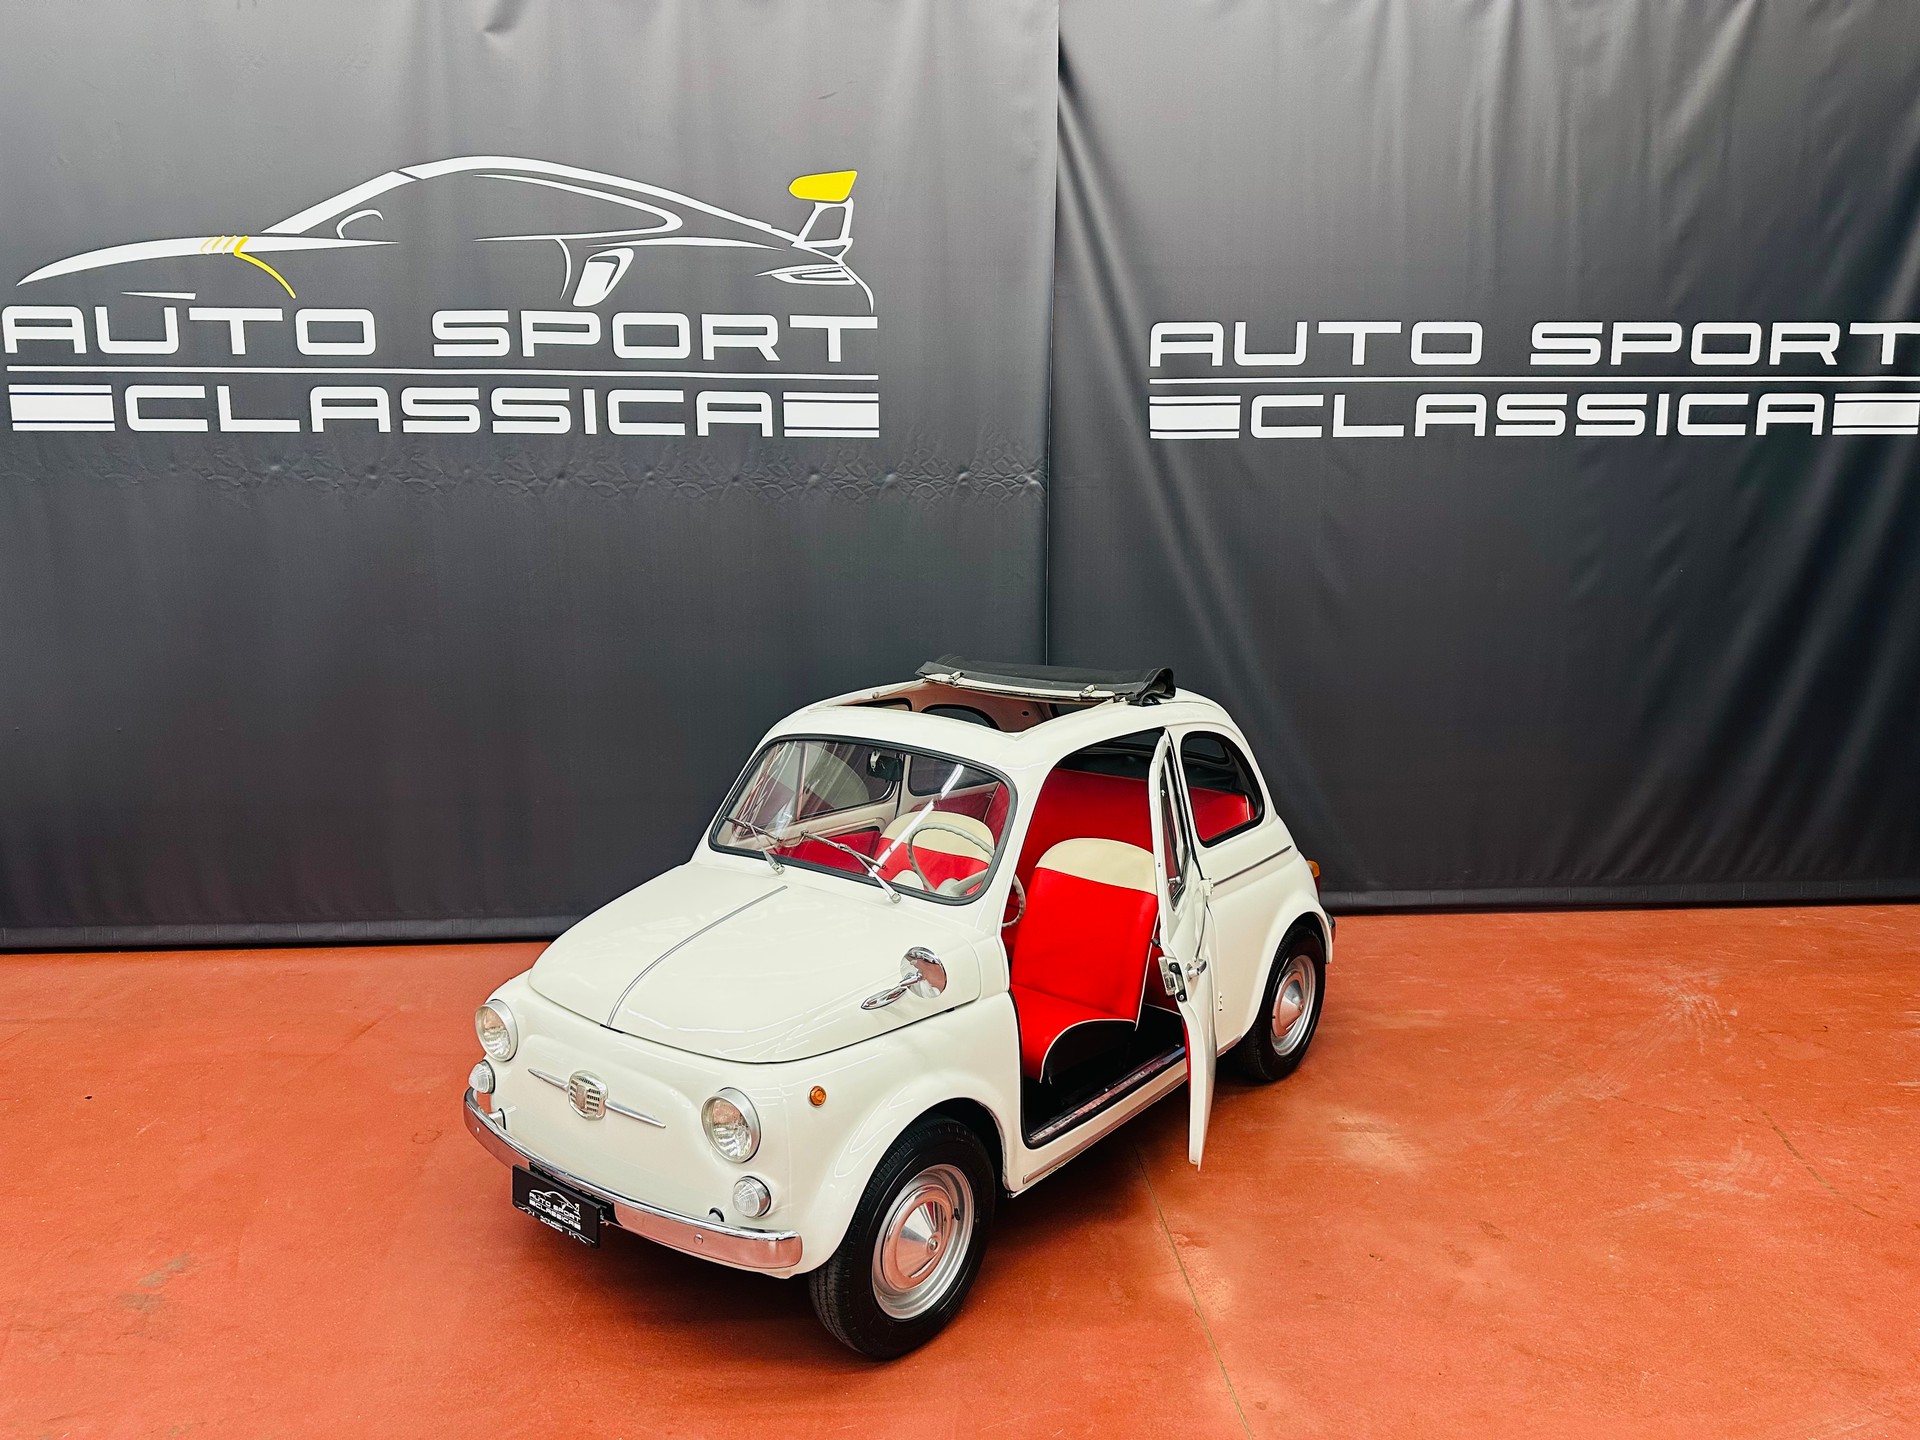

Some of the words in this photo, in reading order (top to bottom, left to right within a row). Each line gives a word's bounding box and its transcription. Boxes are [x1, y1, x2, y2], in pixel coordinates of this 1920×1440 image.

[2, 306, 377, 356] AUTO
[432, 309, 879, 362] SPORT
[1149, 321, 1483, 366] AUTO
[1529, 322, 1920, 366] SPORT
[124, 385, 774, 437] CLASSICA
[1250, 393, 1825, 438] CLASSICA
[529, 1191, 551, 1208] AUTO
[552, 1204, 581, 1223] SPORT
